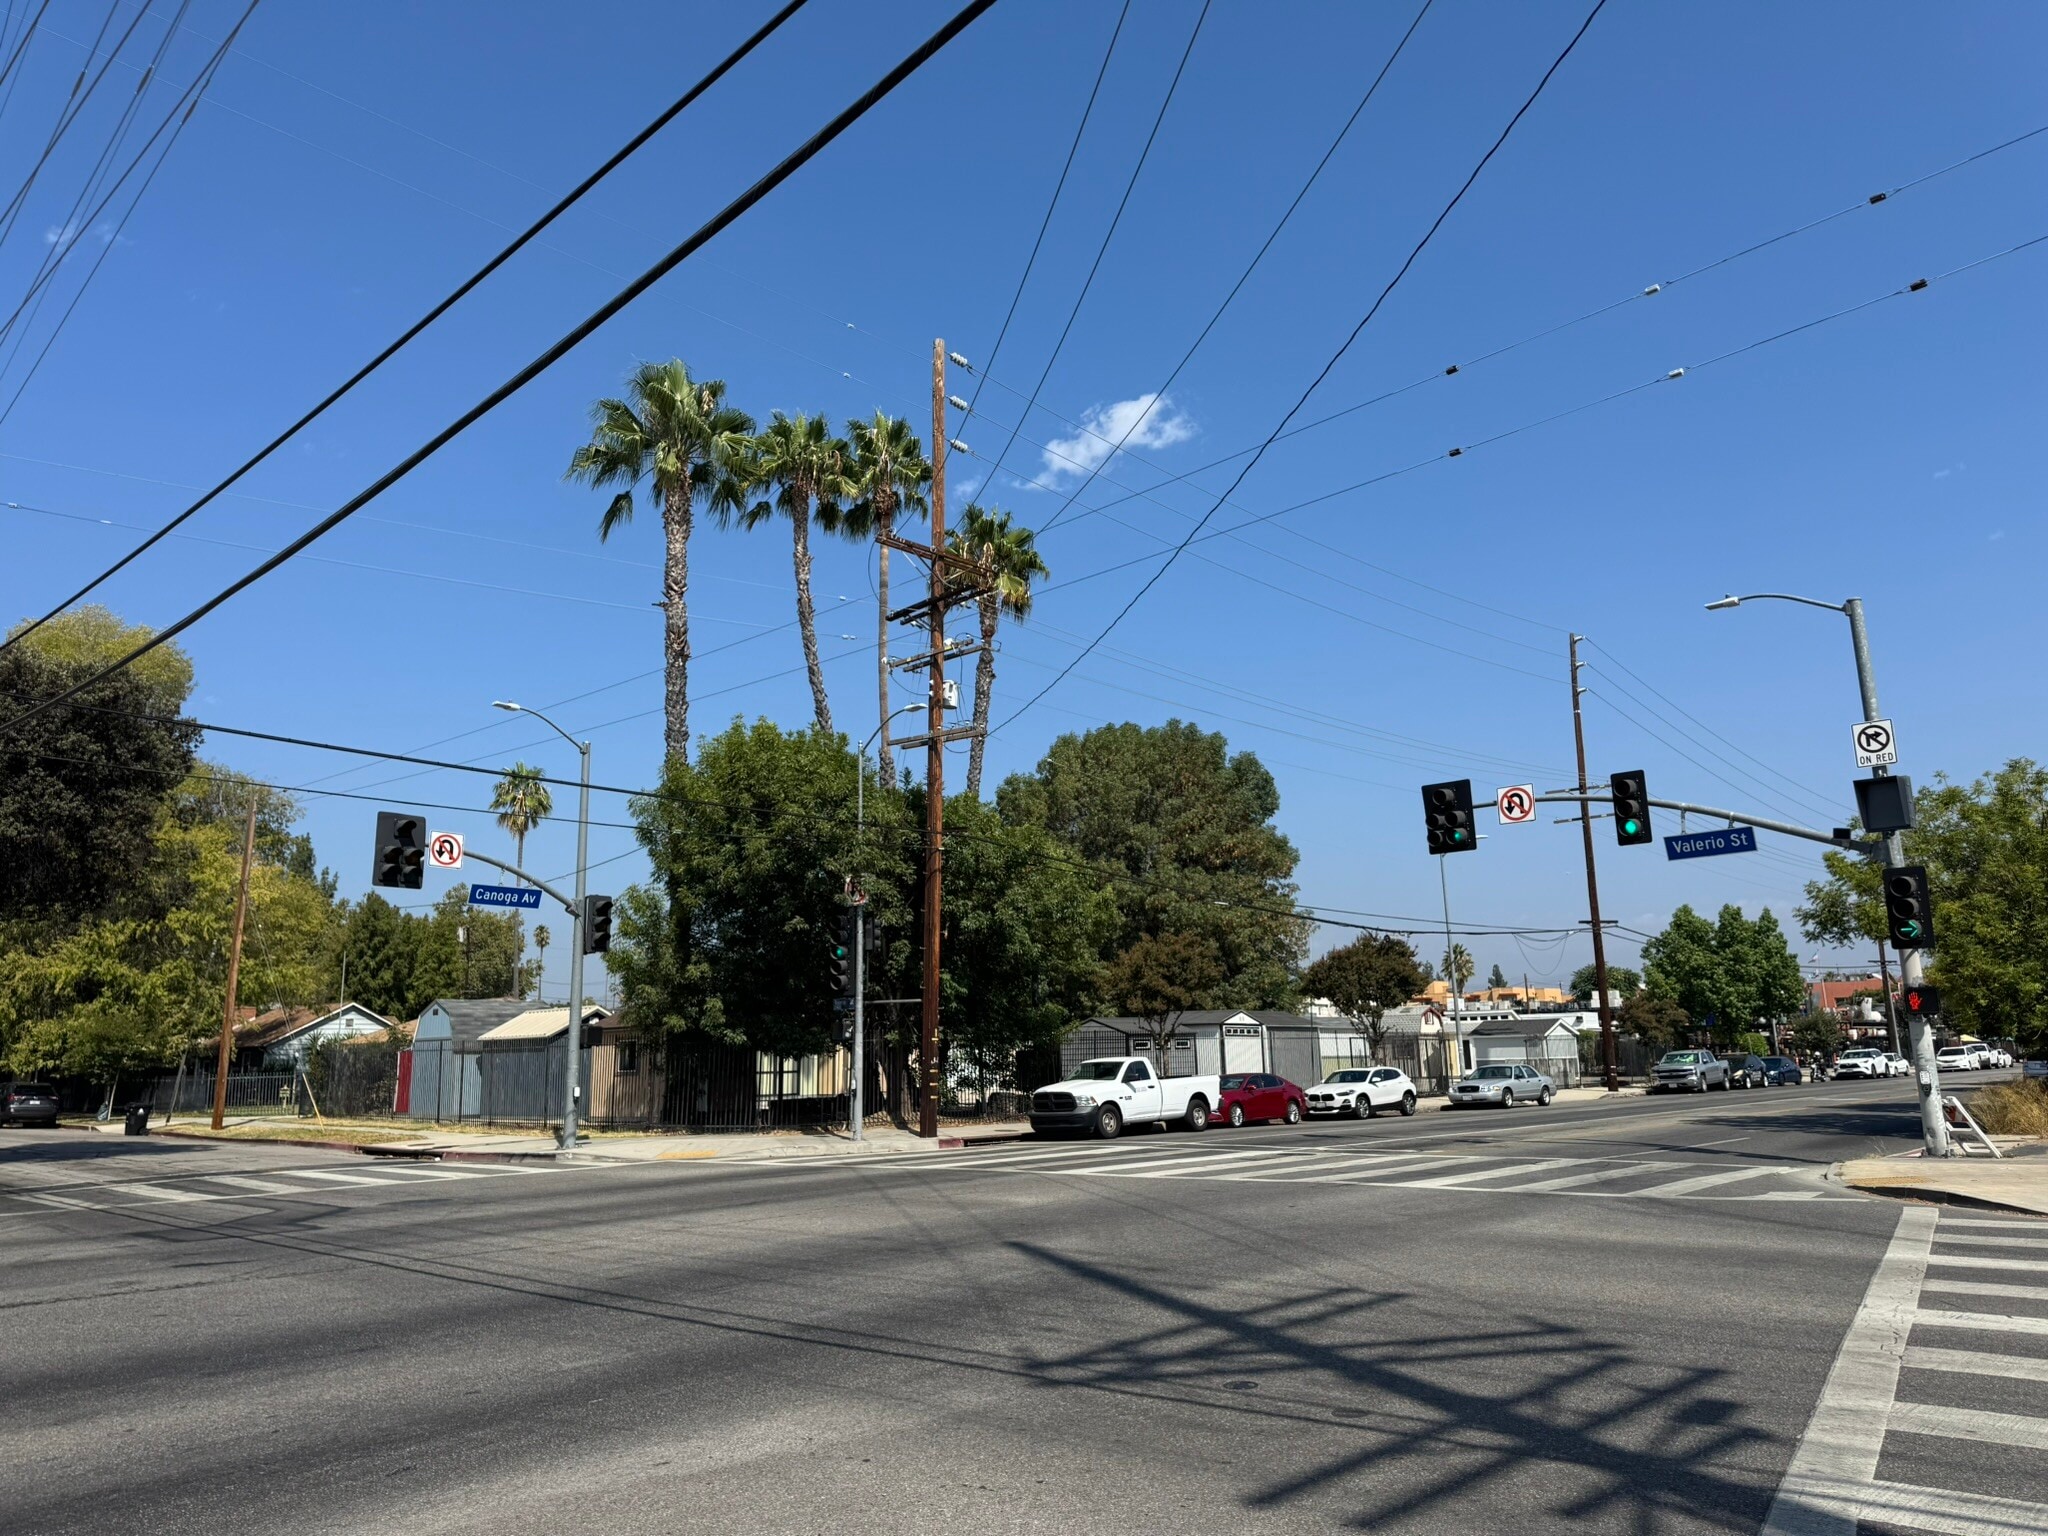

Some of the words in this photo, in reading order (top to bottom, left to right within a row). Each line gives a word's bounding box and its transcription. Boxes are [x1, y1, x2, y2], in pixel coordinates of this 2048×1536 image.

[1859, 755, 1872, 765] ON
[1876, 752, 1894, 763] RED
[1672, 836, 1725, 853] Valerio
[1730, 833, 1748, 847] St
[475, 888, 518, 904] Canoga
[521, 892, 536, 903] Av
